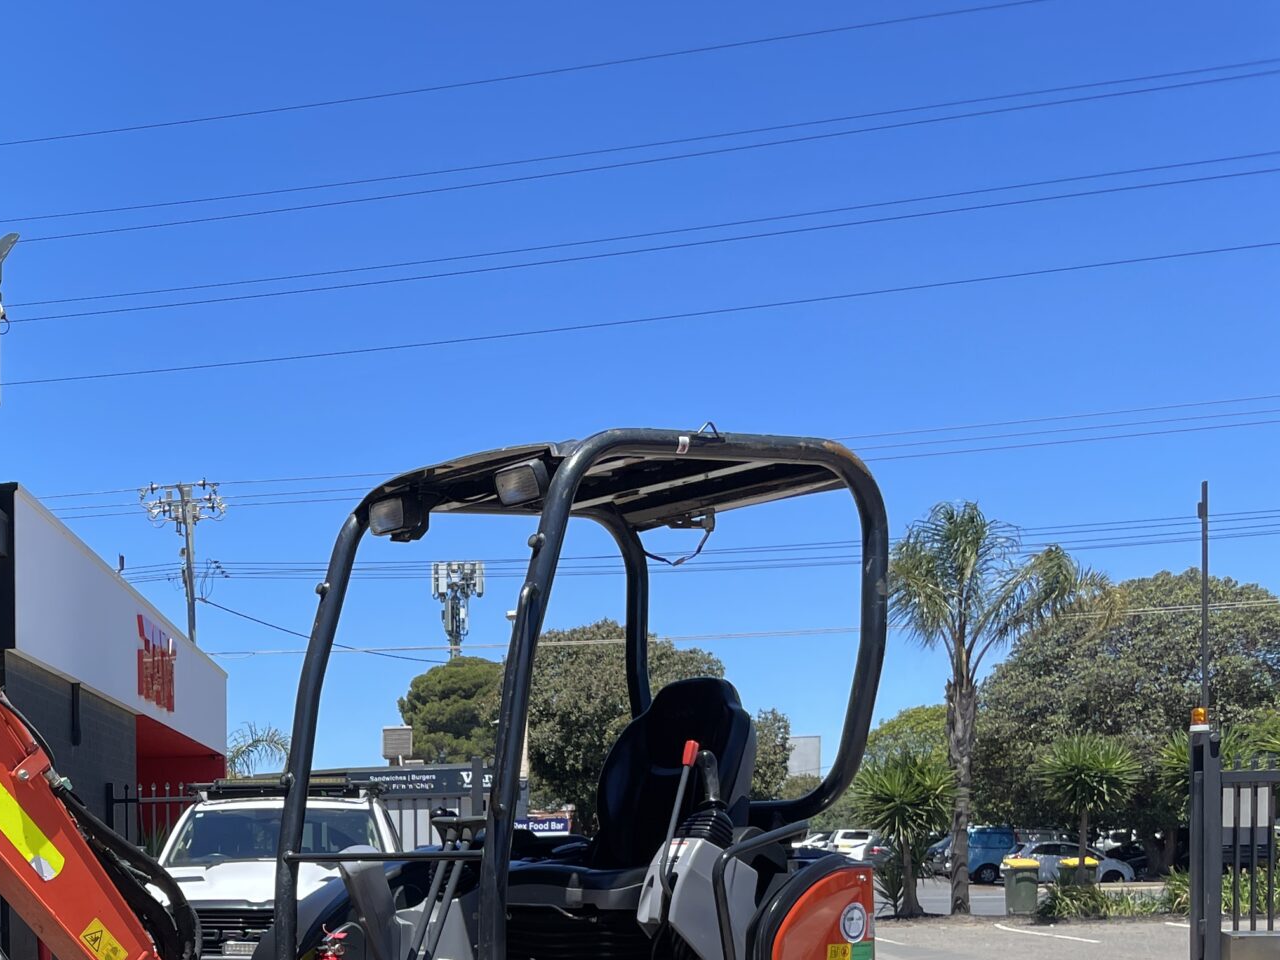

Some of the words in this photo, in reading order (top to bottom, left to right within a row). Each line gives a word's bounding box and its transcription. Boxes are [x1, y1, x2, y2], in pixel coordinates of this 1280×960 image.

[411, 773, 437, 781] Burgers
[528, 821, 550, 831] Food
[550, 821, 565, 830] Bar
